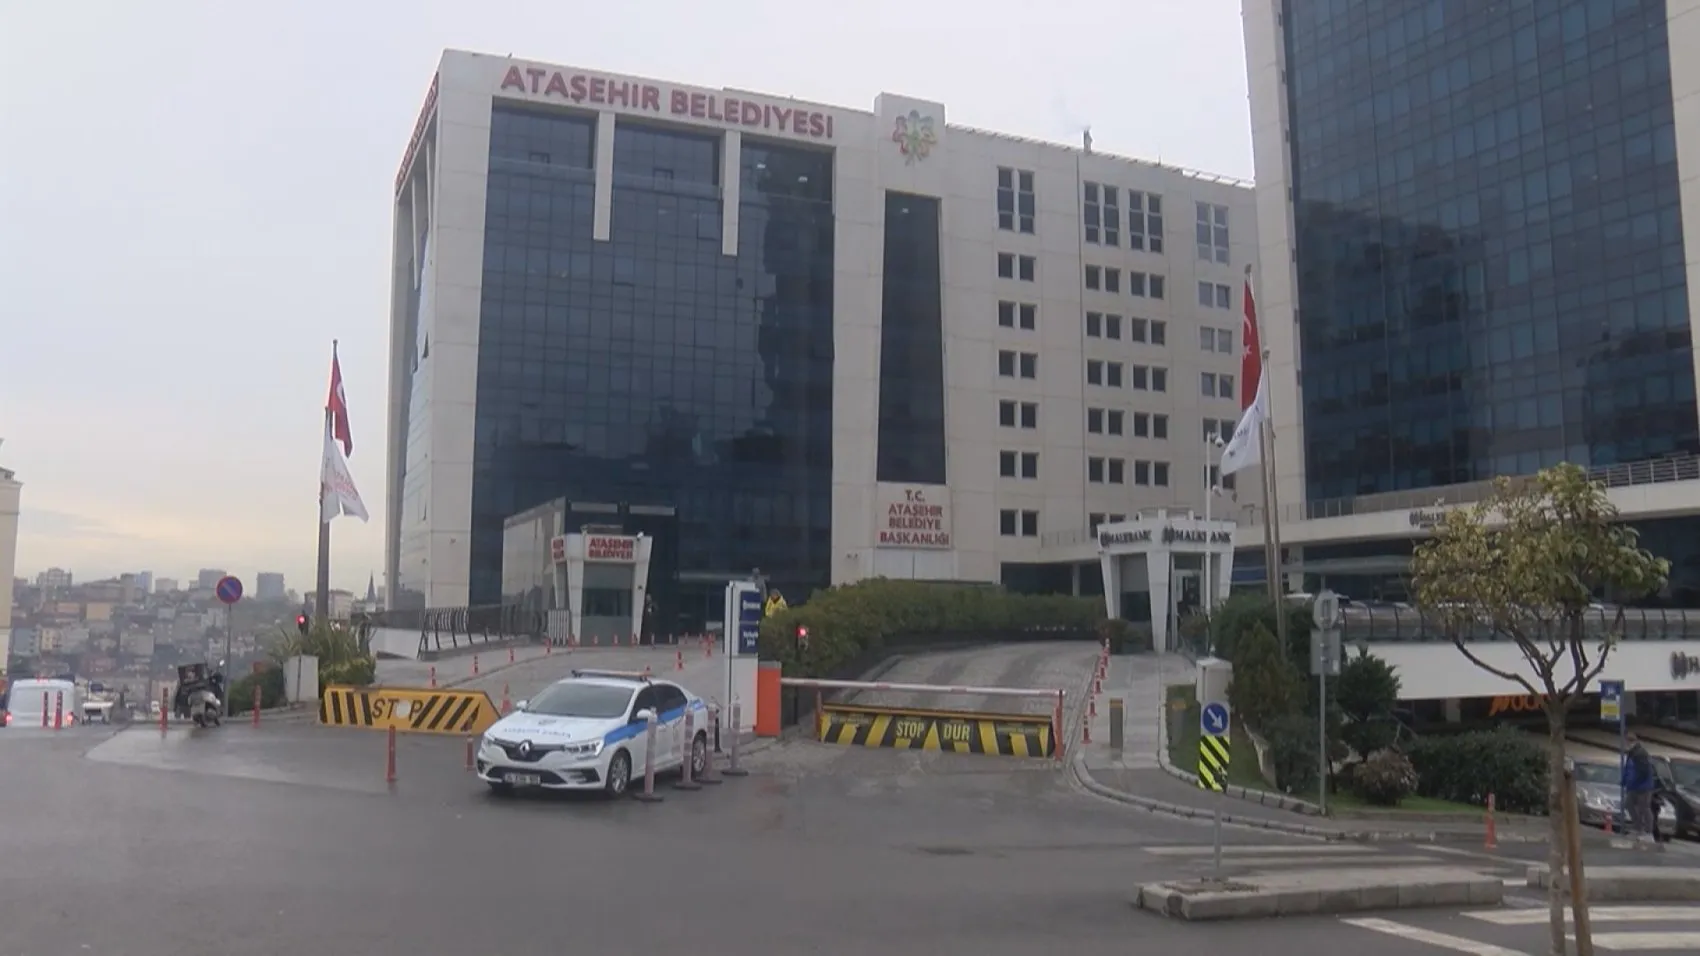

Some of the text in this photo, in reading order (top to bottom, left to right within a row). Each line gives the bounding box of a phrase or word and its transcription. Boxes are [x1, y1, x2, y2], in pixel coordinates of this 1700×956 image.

[371, 698, 425, 722] STP
[896, 721, 971, 741] STOP DUR
